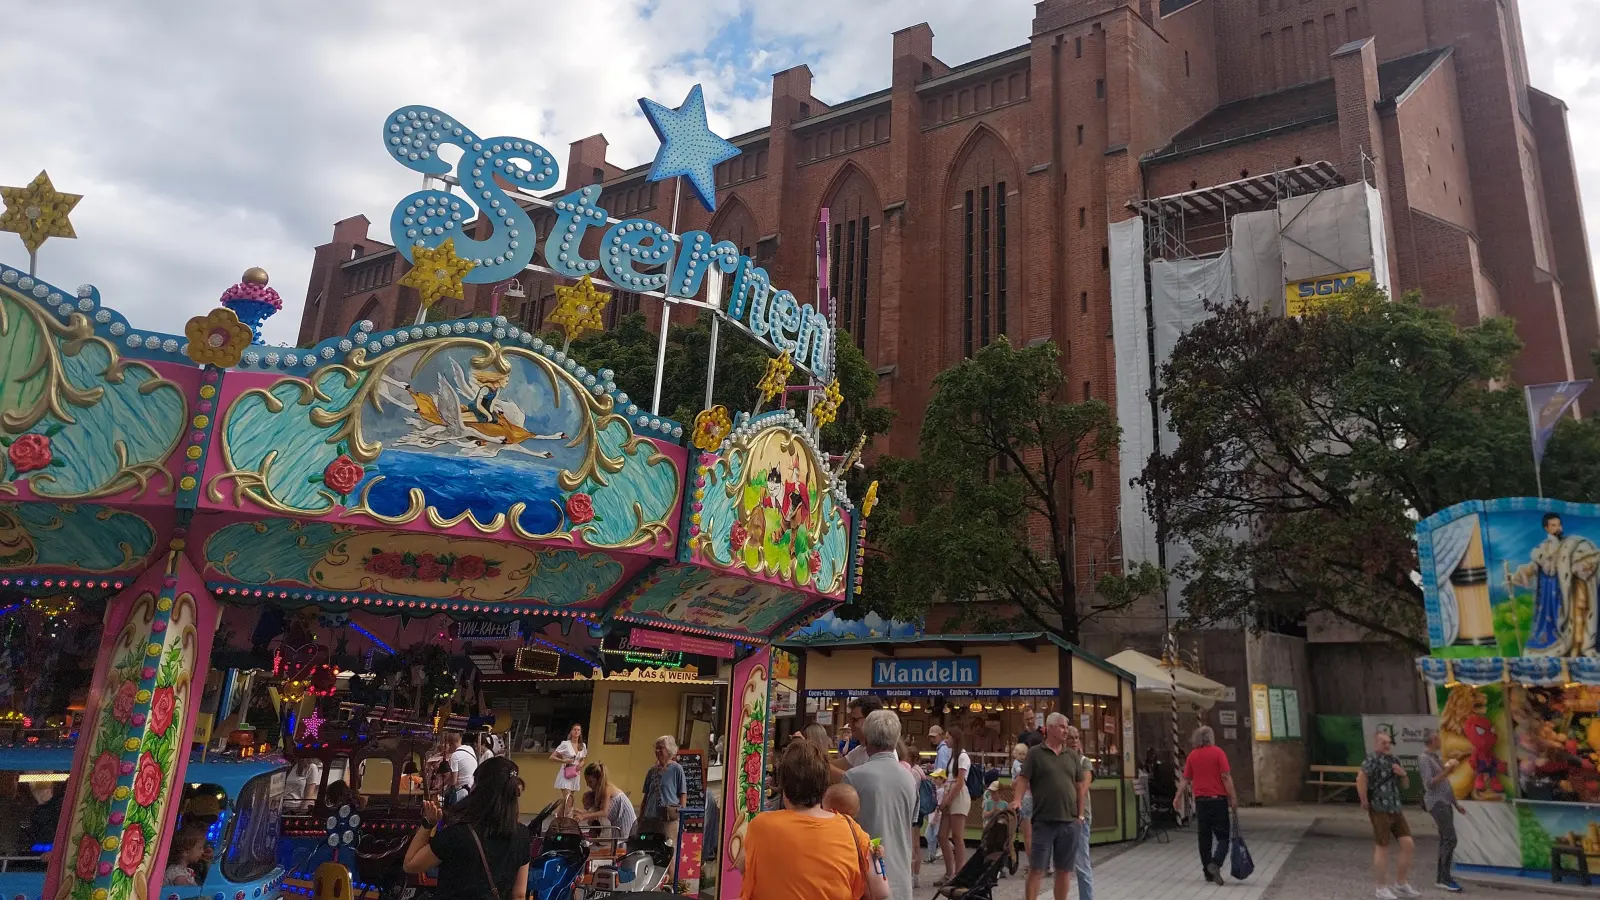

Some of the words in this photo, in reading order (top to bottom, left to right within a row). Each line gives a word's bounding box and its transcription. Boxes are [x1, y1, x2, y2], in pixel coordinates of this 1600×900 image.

[383, 105, 829, 377] Sternen
[1298, 276, 1355, 298] SGM
[638, 671, 657, 679] KAS
[878, 660, 973, 683] Mandeln
